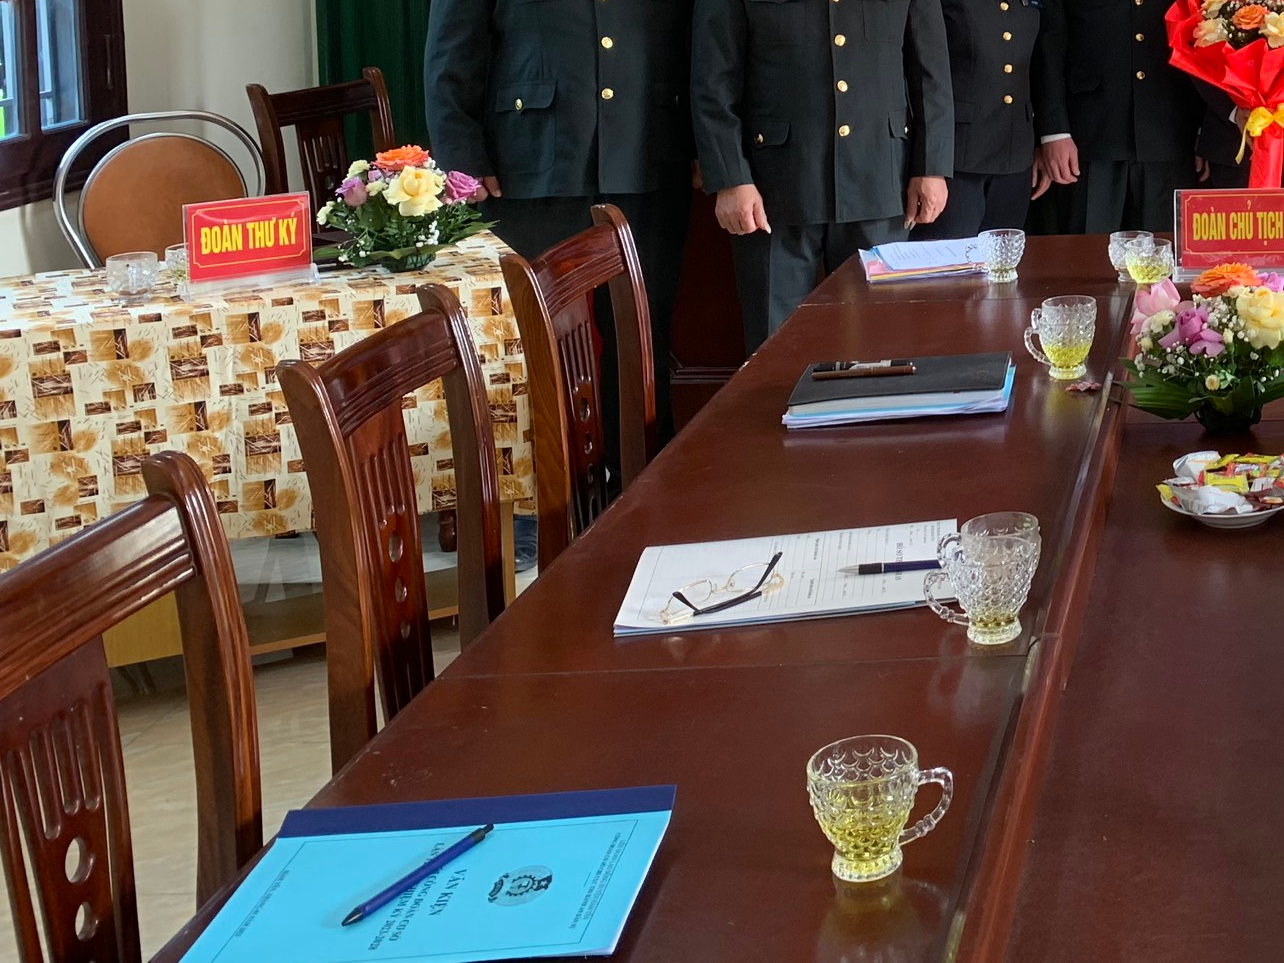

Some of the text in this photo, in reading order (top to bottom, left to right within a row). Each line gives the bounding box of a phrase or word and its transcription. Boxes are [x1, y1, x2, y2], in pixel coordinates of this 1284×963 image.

[201, 211, 297, 254] ĐOÀN THƯ KÝ
[1192, 199, 1284, 246] ĐOÀN CHỦ TỊCH
